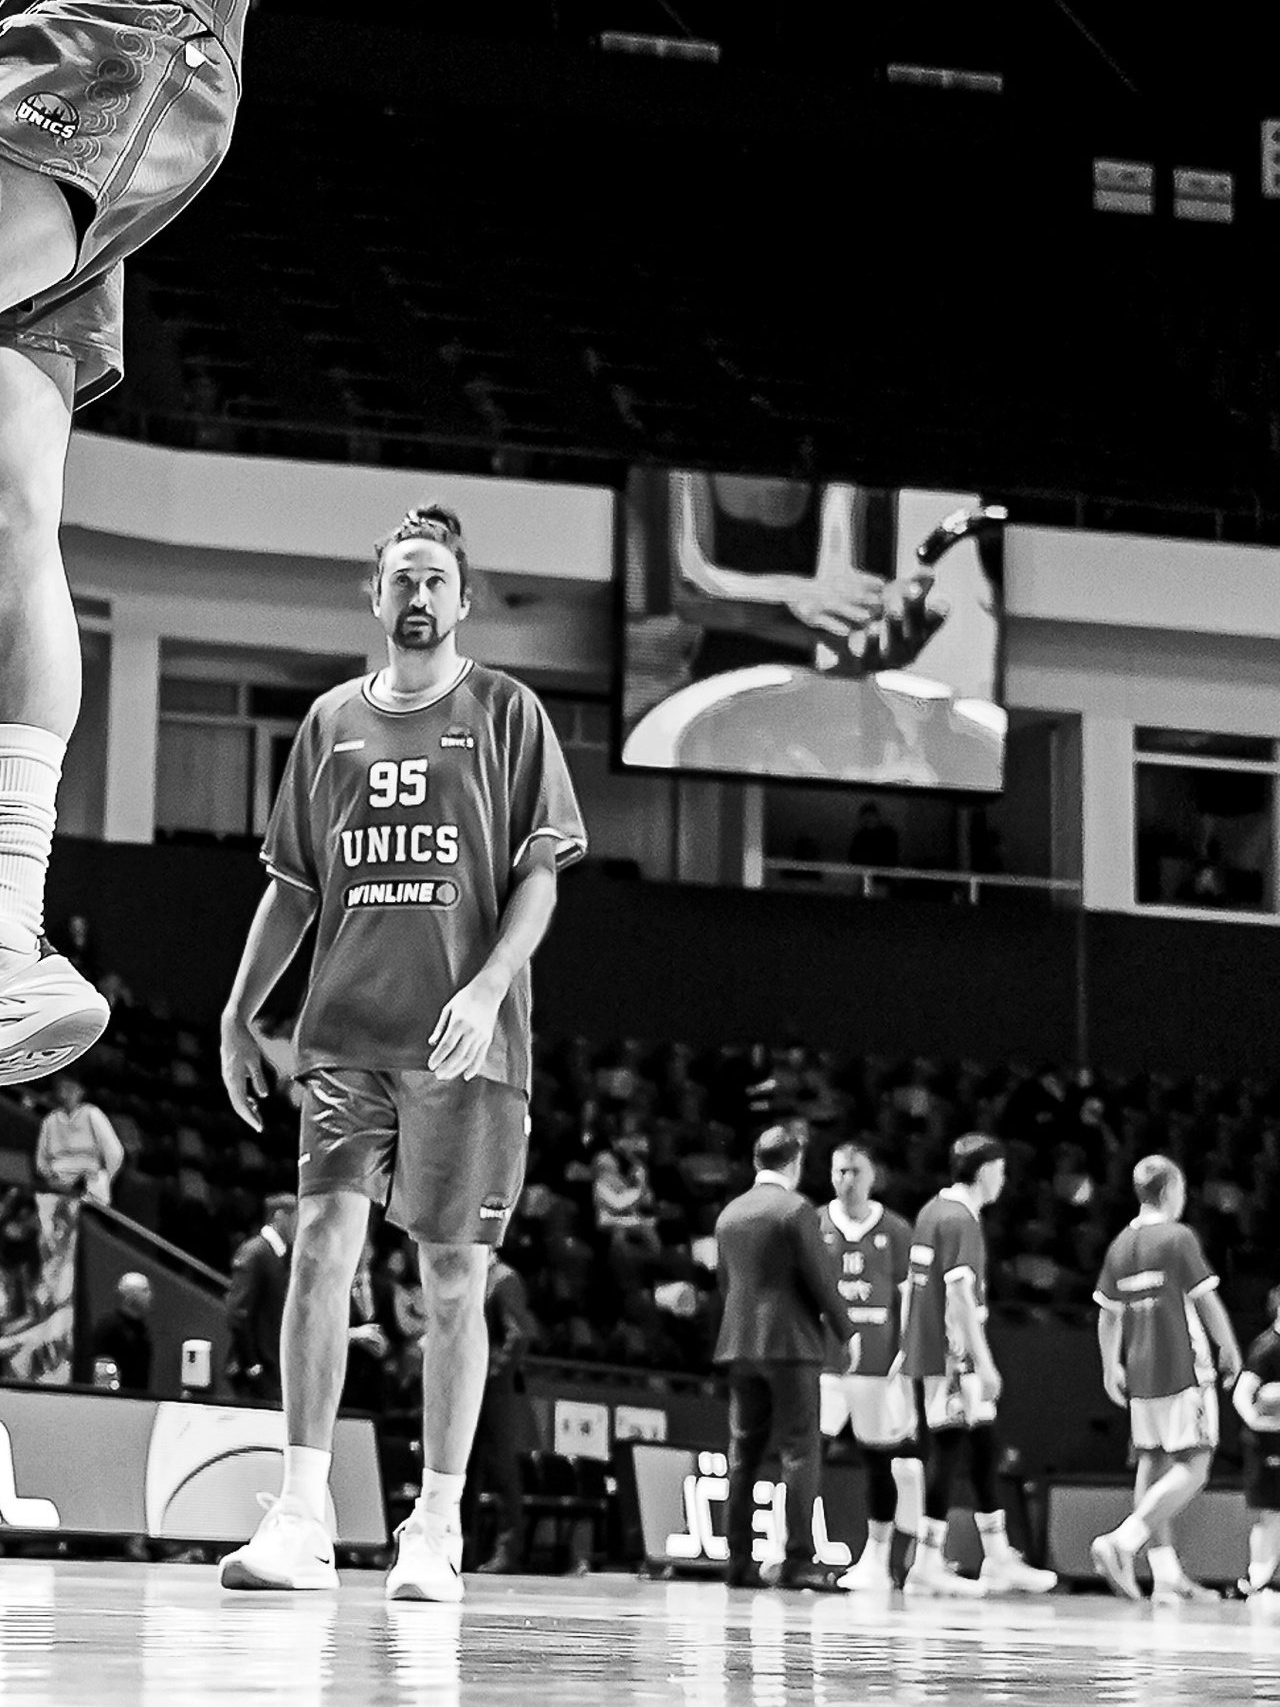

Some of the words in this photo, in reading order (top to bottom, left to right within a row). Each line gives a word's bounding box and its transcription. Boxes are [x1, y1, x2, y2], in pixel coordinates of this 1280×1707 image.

[17, 101, 76, 139] UNICS
[369, 758, 428, 808] 95
[341, 825, 459, 867] UNICS
[347, 882, 435, 907] WINLINE
